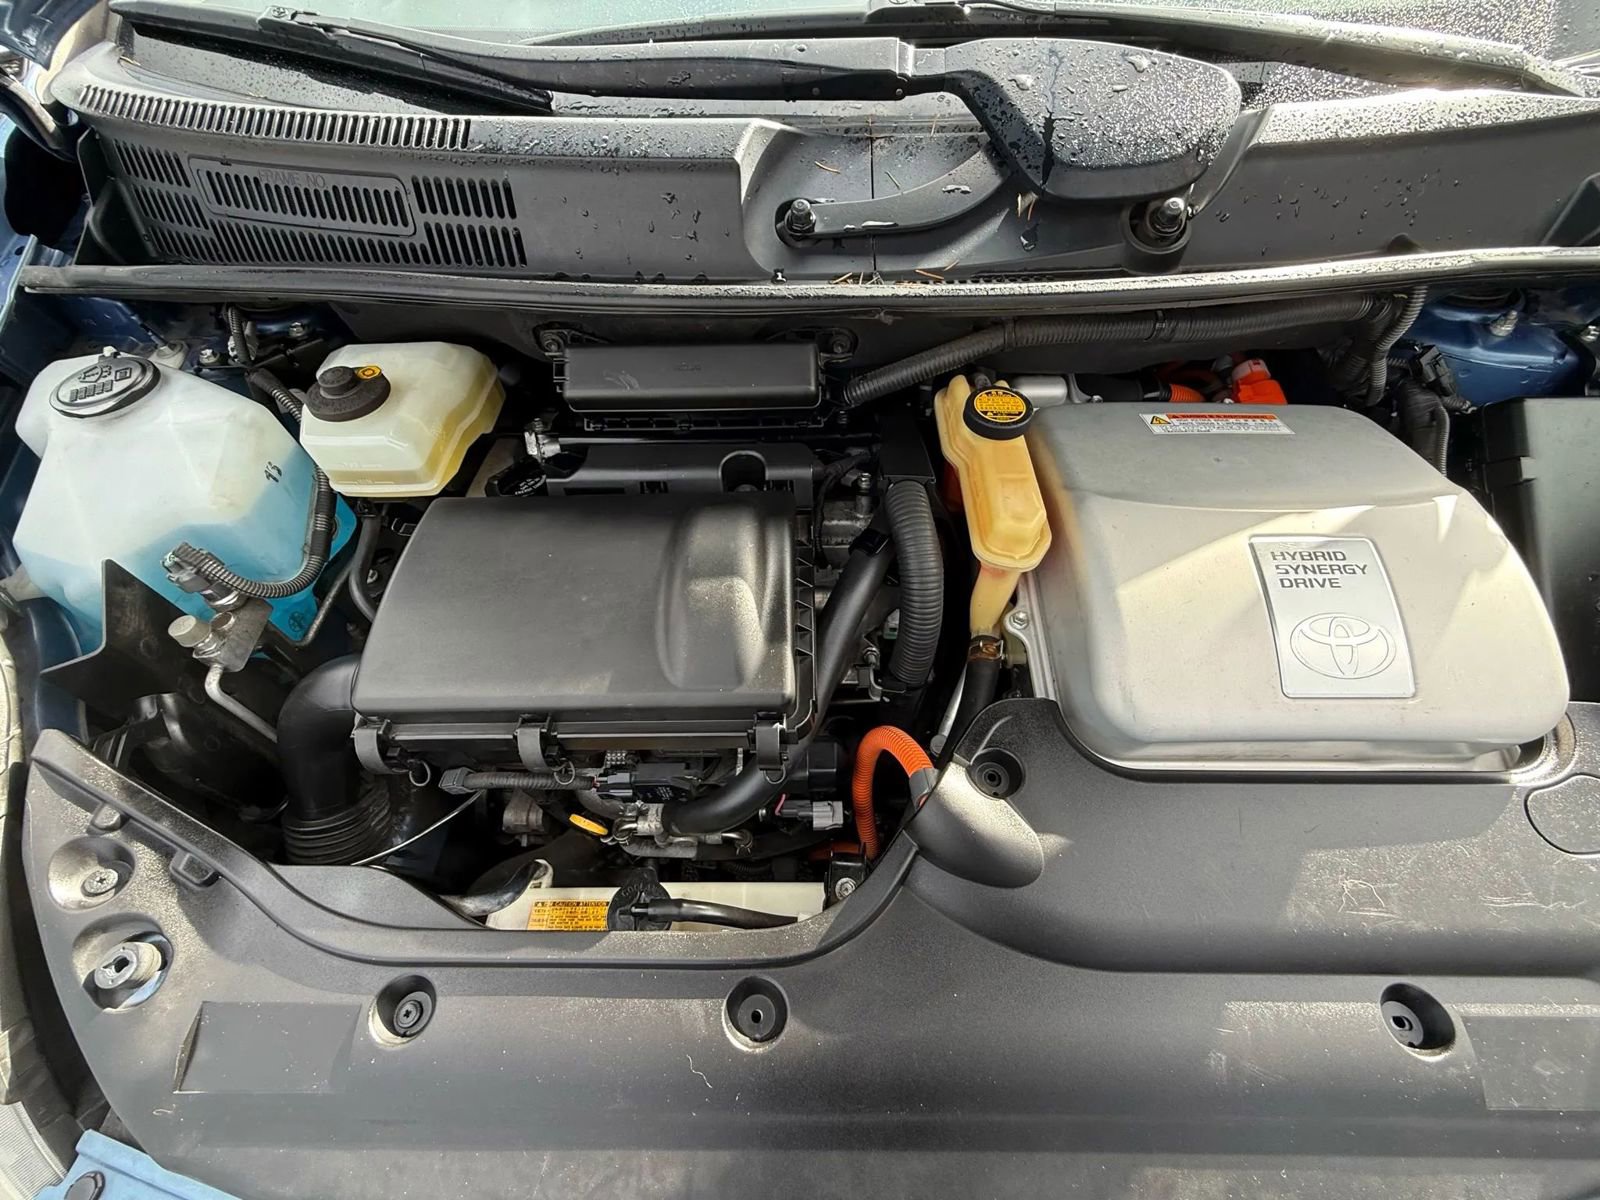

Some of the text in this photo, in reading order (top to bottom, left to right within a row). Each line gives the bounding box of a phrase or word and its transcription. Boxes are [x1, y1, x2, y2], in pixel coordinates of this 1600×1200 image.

[258, 169, 329, 189] FRAME NO.
[1270, 551, 1347, 562] HYBRID
[1275, 564, 1368, 575] SYNERGY
[1279, 578, 1342, 588] DRIVE
